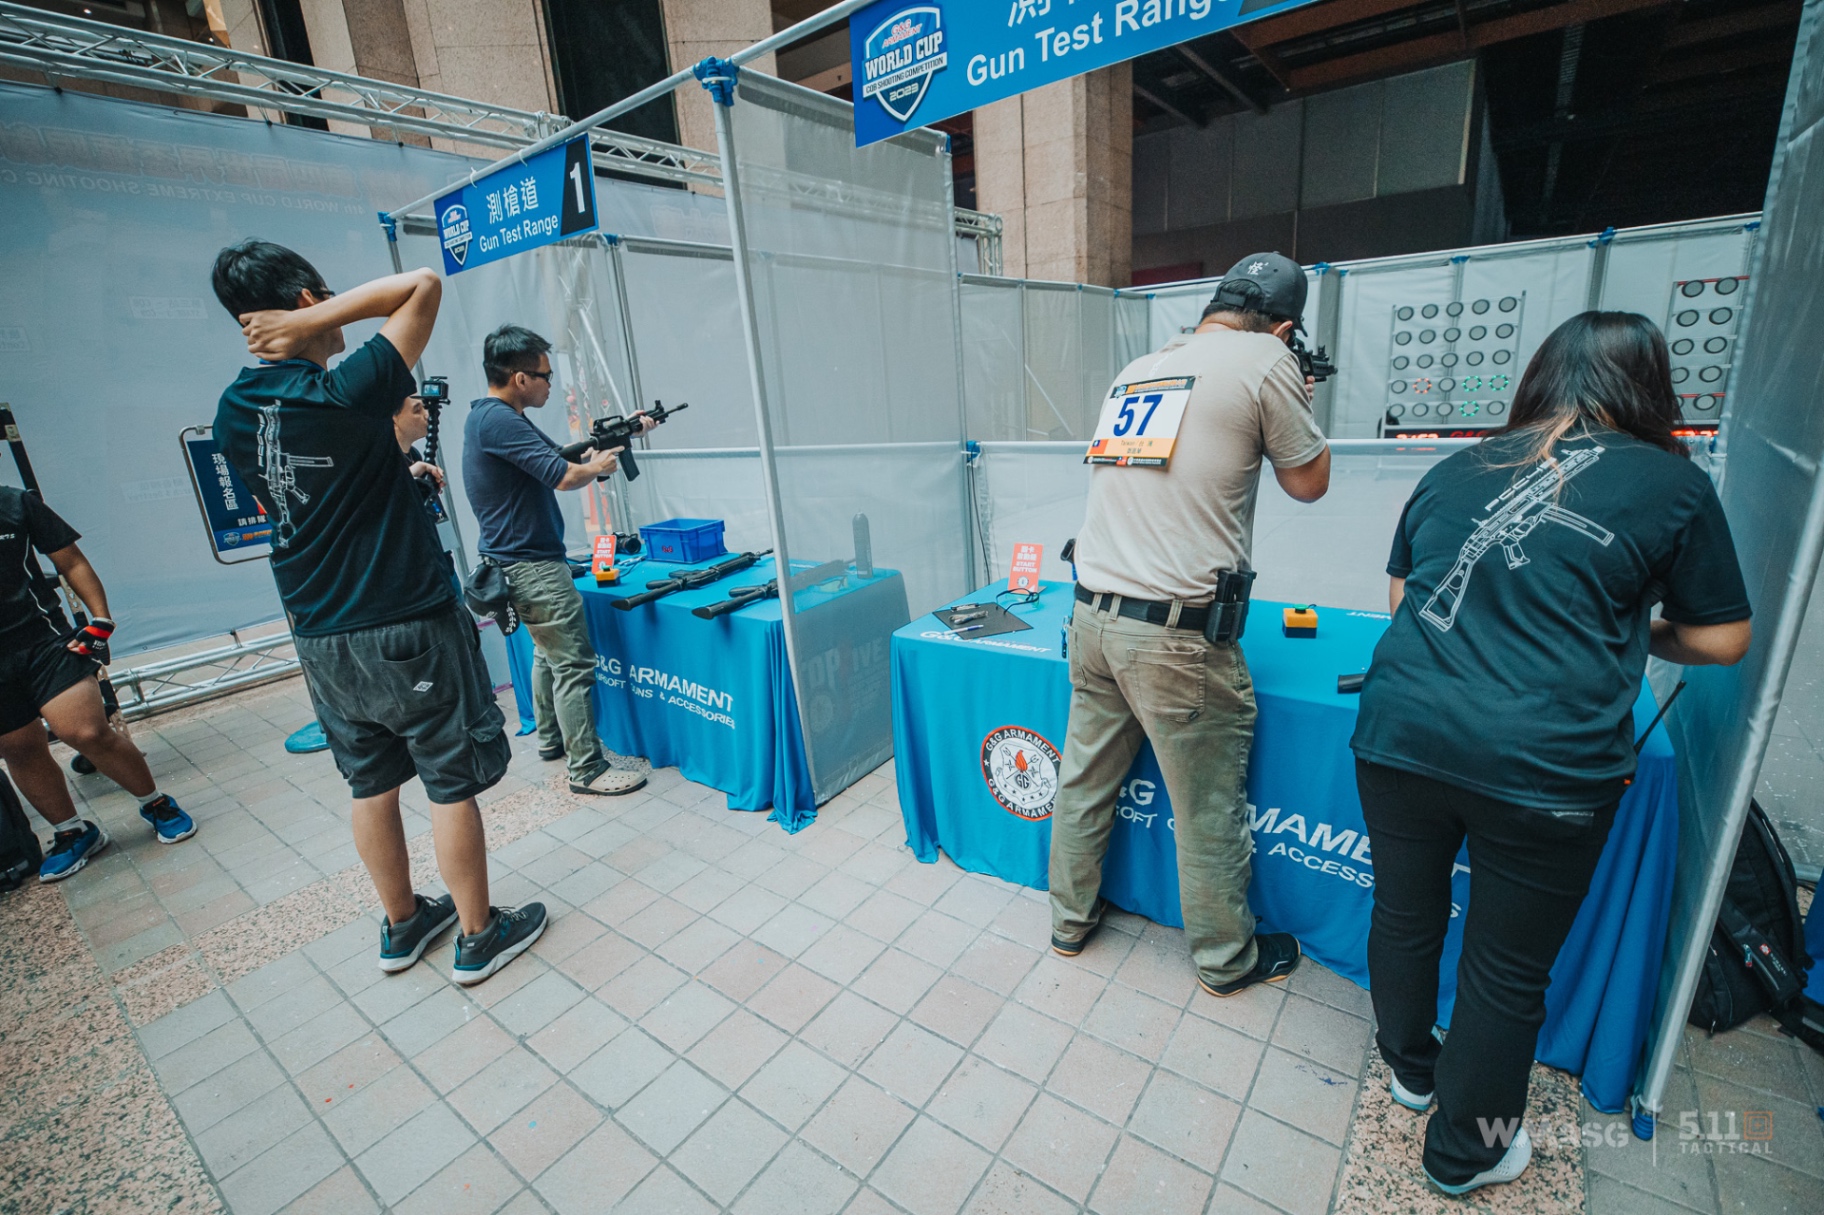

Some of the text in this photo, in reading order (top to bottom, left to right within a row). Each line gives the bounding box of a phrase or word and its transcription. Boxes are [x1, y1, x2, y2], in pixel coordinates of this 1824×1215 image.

[865, 30, 943, 81] WORLD CUP
[967, 47, 1025, 87] Gun
[1034, 10, 1104, 63] Test
[1115, 0, 1228, 37] Rang
[877, 73, 905, 91] SHOOTING
[904, 56, 944, 79] COMPETITION
[889, 82, 919, 102] 2023
[486, 176, 539, 225] 測槍道
[569, 161, 586, 214] 1
[479, 235, 499, 252] Gun
[500, 224, 523, 246] Test
[522, 215, 559, 238] Range
[1113, 394, 1164, 437] 57
[211, 452, 239, 511] 現場報名區
[629, 664, 734, 713] ARMAMENT
[985, 729, 1061, 763] G&G ARMAMENT
